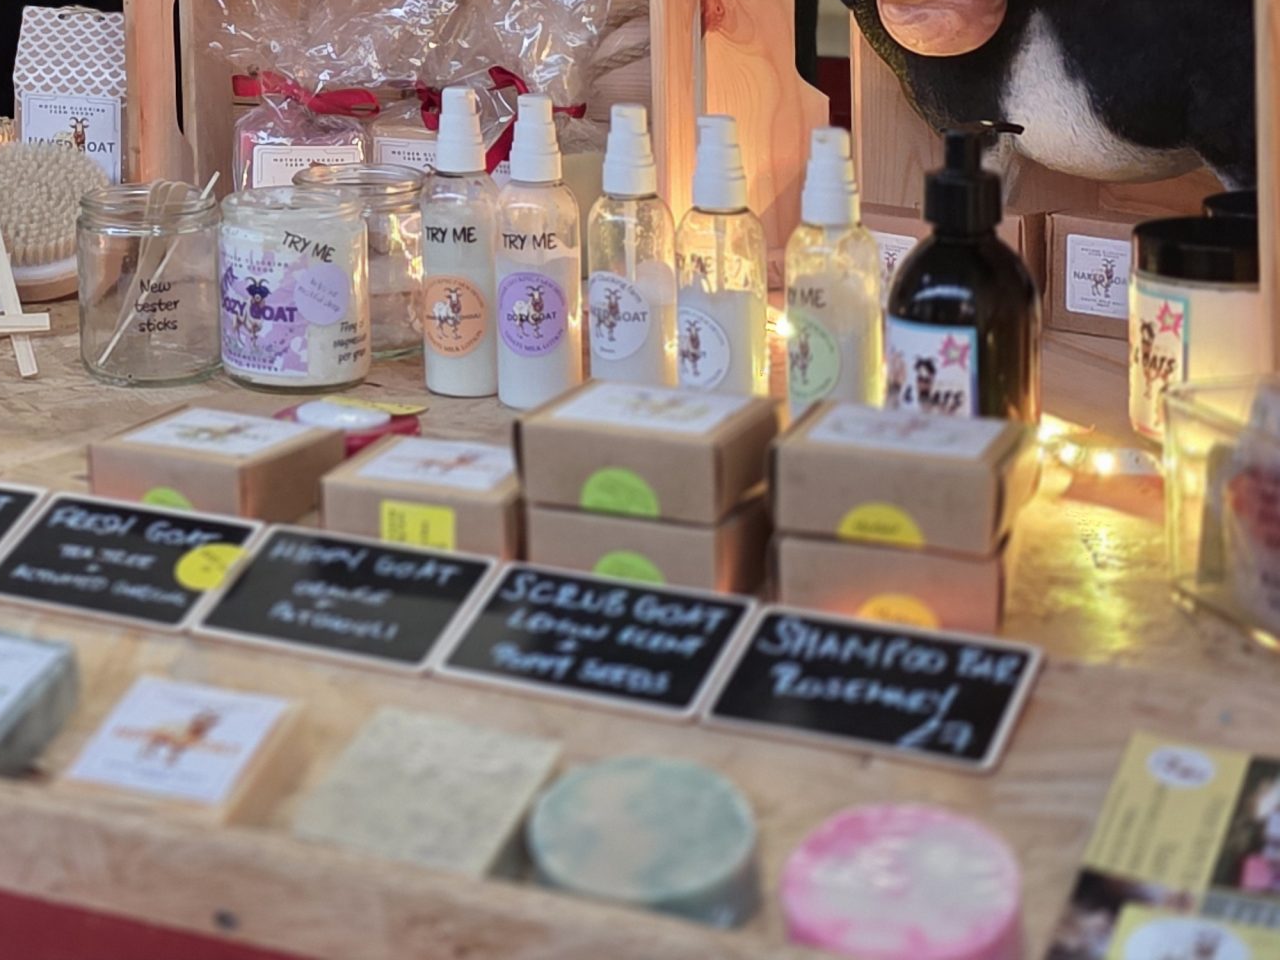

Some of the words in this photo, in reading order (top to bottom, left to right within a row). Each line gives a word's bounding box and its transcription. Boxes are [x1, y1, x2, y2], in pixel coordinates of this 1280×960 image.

[426, 226, 448, 244] TRY
[452, 226, 478, 244] ME
[502, 233, 527, 251] TRY
[532, 233, 558, 250] ME
[282, 230, 311, 254] TRY
[311, 243, 336, 263] ME
[140, 279, 171, 293] New
[134, 296, 180, 314] tester
[803, 287, 827, 308] ME
[250, 303, 298, 323] GOAT
[138, 319, 178, 333] sticks
[372, 554, 462, 588] GOAT
[499, 570, 630, 617] SCRUB
[632, 593, 731, 636] GOAT
[754, 614, 950, 676] SHAMPOO
[954, 646, 1024, 686] BAR
